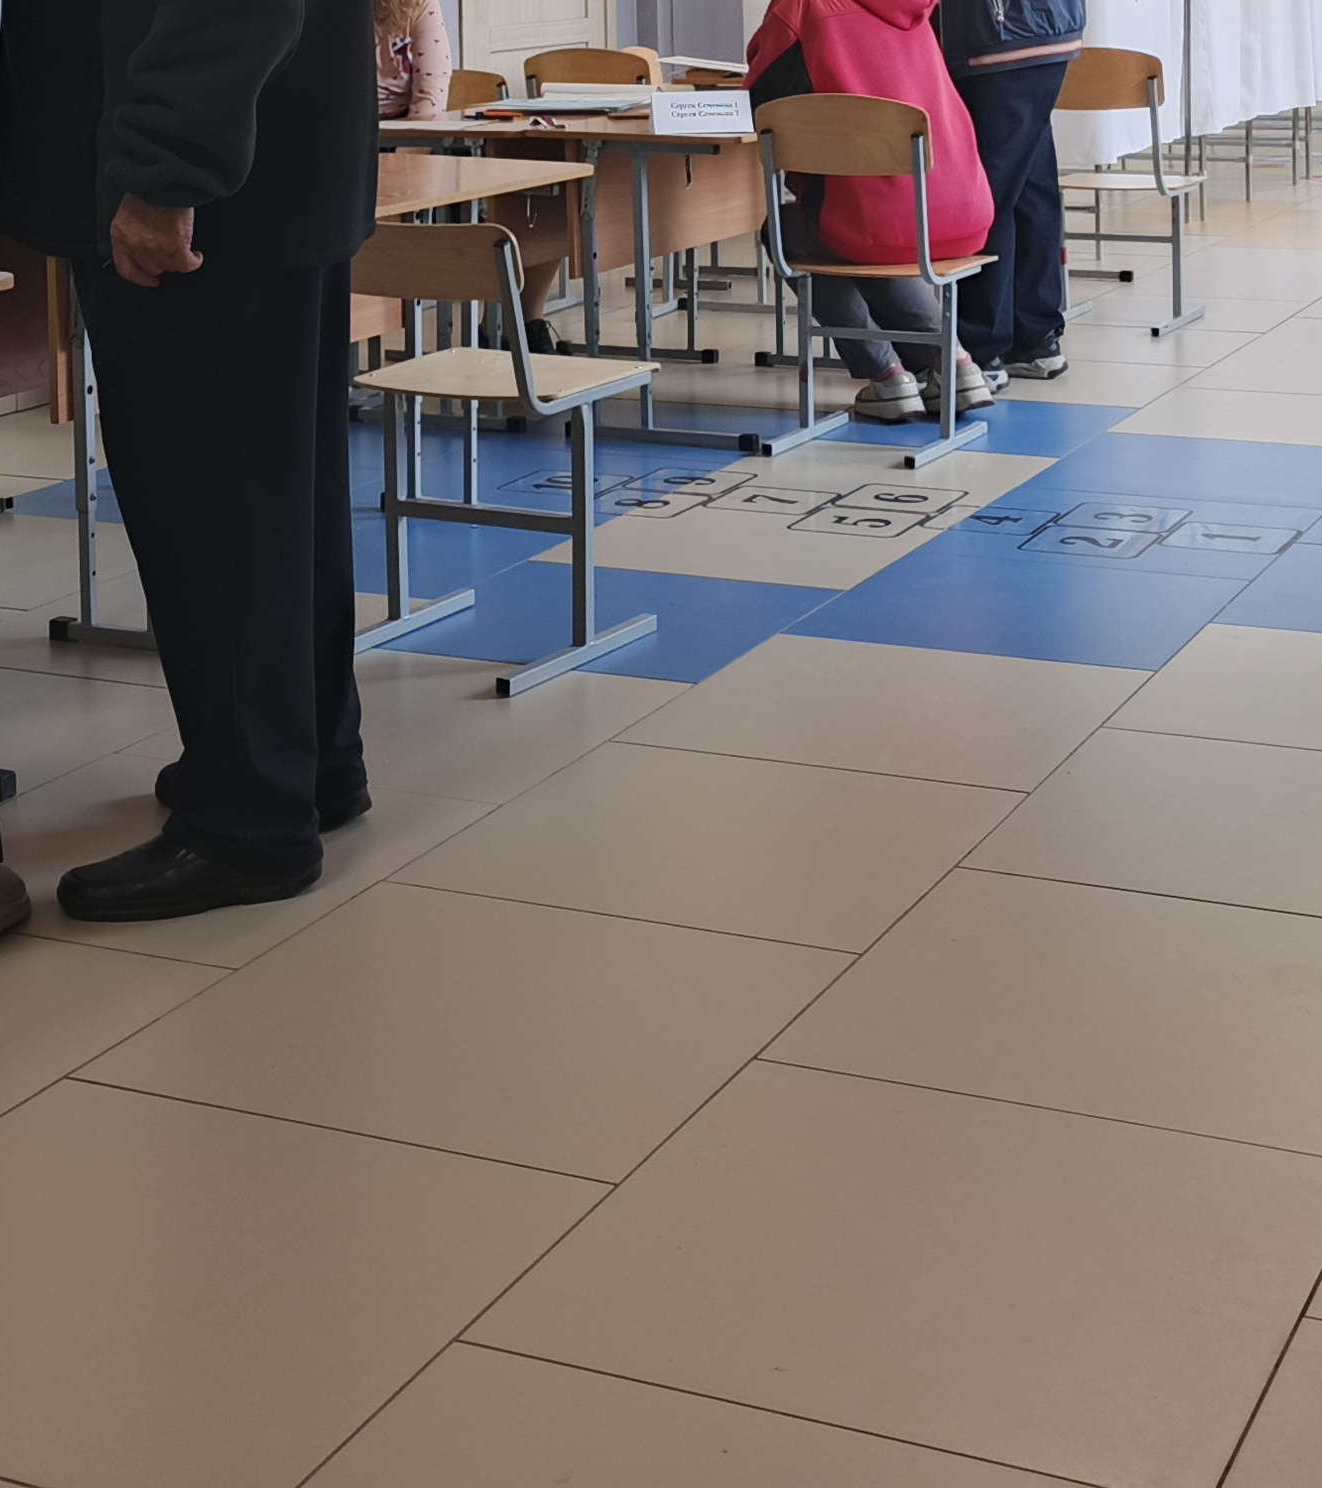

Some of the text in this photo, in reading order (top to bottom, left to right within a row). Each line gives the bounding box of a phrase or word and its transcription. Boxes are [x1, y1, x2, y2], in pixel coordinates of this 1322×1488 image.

[614, 498, 670, 509] 8
[742, 494, 798, 505] 7
[832, 515, 892, 529] 5
[970, 514, 1023, 526] 4
[1093, 512, 1153, 524] 3
[1059, 535, 1125, 550] 2
[1201, 532, 1262, 543] 1
